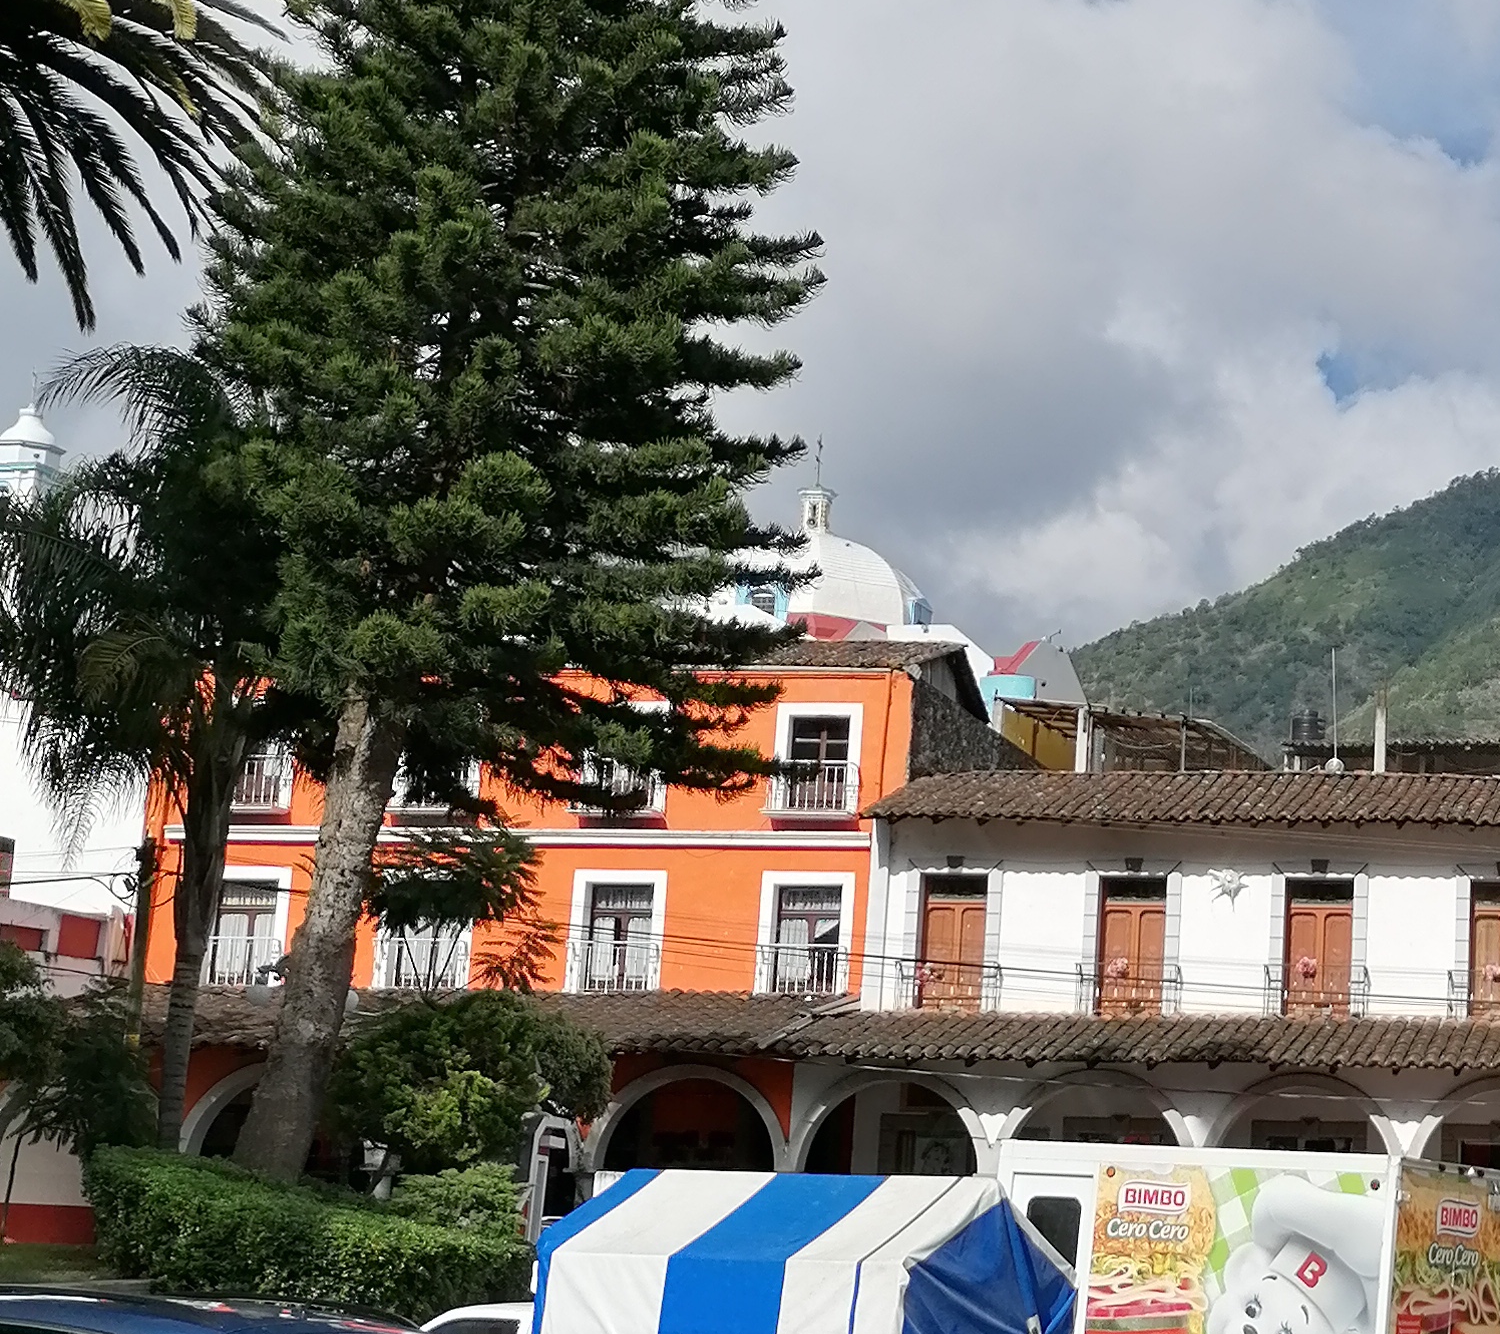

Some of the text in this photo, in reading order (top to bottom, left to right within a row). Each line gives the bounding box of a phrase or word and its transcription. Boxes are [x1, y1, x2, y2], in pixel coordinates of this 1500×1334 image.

[1124, 1188, 1186, 1207] BIMBO
[1107, 1217, 1189, 1241] Cero Cero
[1440, 1206, 1478, 1229] BIMBO
[1428, 1242, 1478, 1267] Cero Cero
